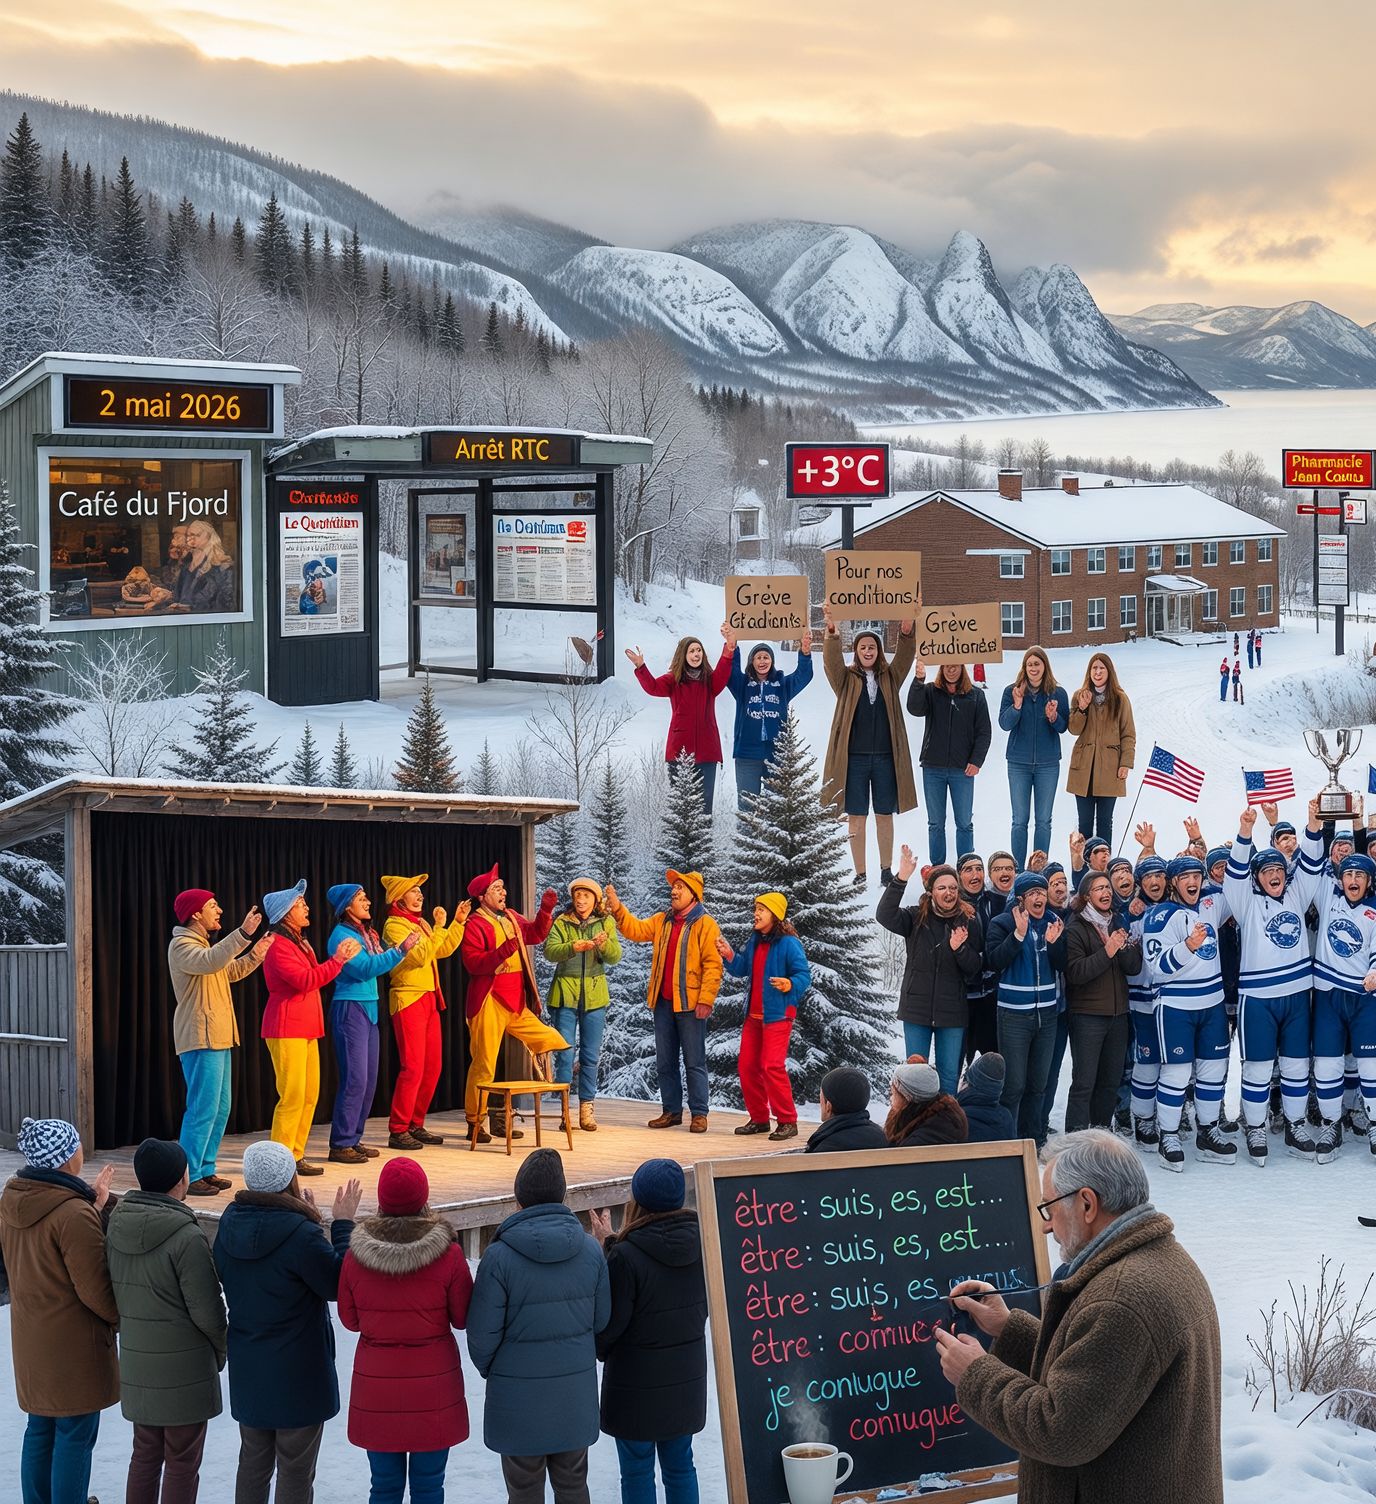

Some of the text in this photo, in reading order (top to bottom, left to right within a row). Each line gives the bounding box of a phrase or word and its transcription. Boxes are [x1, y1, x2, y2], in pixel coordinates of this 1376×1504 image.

[100, 389, 241, 420] 2 mai 2026
[455, 437, 550, 461] Arrêt RTC
[797, 454, 880, 487] +3°C
[58, 489, 228, 522] Café du Fjord
[835, 556, 903, 580] Pour nos
[829, 581, 920, 605] conditions!
[925, 611, 978, 634] Grève
[820, 1188, 882, 1219] suis,
[891, 1190, 926, 1214] es,
[823, 1234, 884, 1264] suis,
[893, 1234, 929, 1260] es,
[830, 1277, 898, 1310] suis,
[765, 1377, 794, 1431] je
